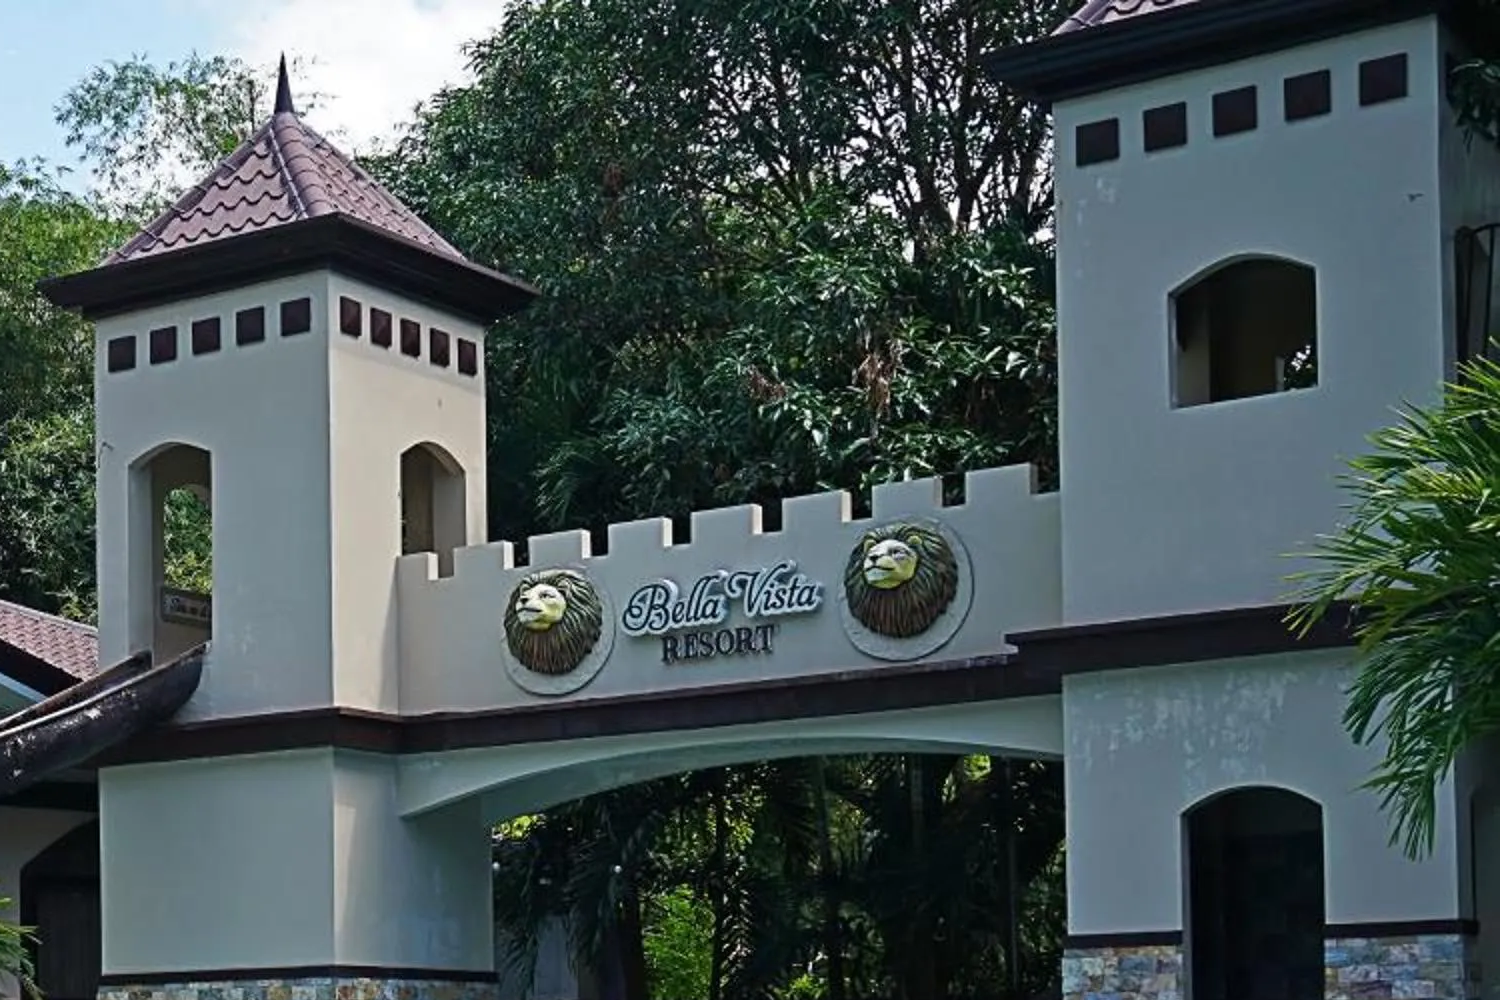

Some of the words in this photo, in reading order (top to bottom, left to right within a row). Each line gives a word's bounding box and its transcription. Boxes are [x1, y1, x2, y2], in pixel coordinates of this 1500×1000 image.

[622, 573, 722, 632] Bella
[726, 562, 819, 614] Vista
[662, 624, 775, 664] RESORT
